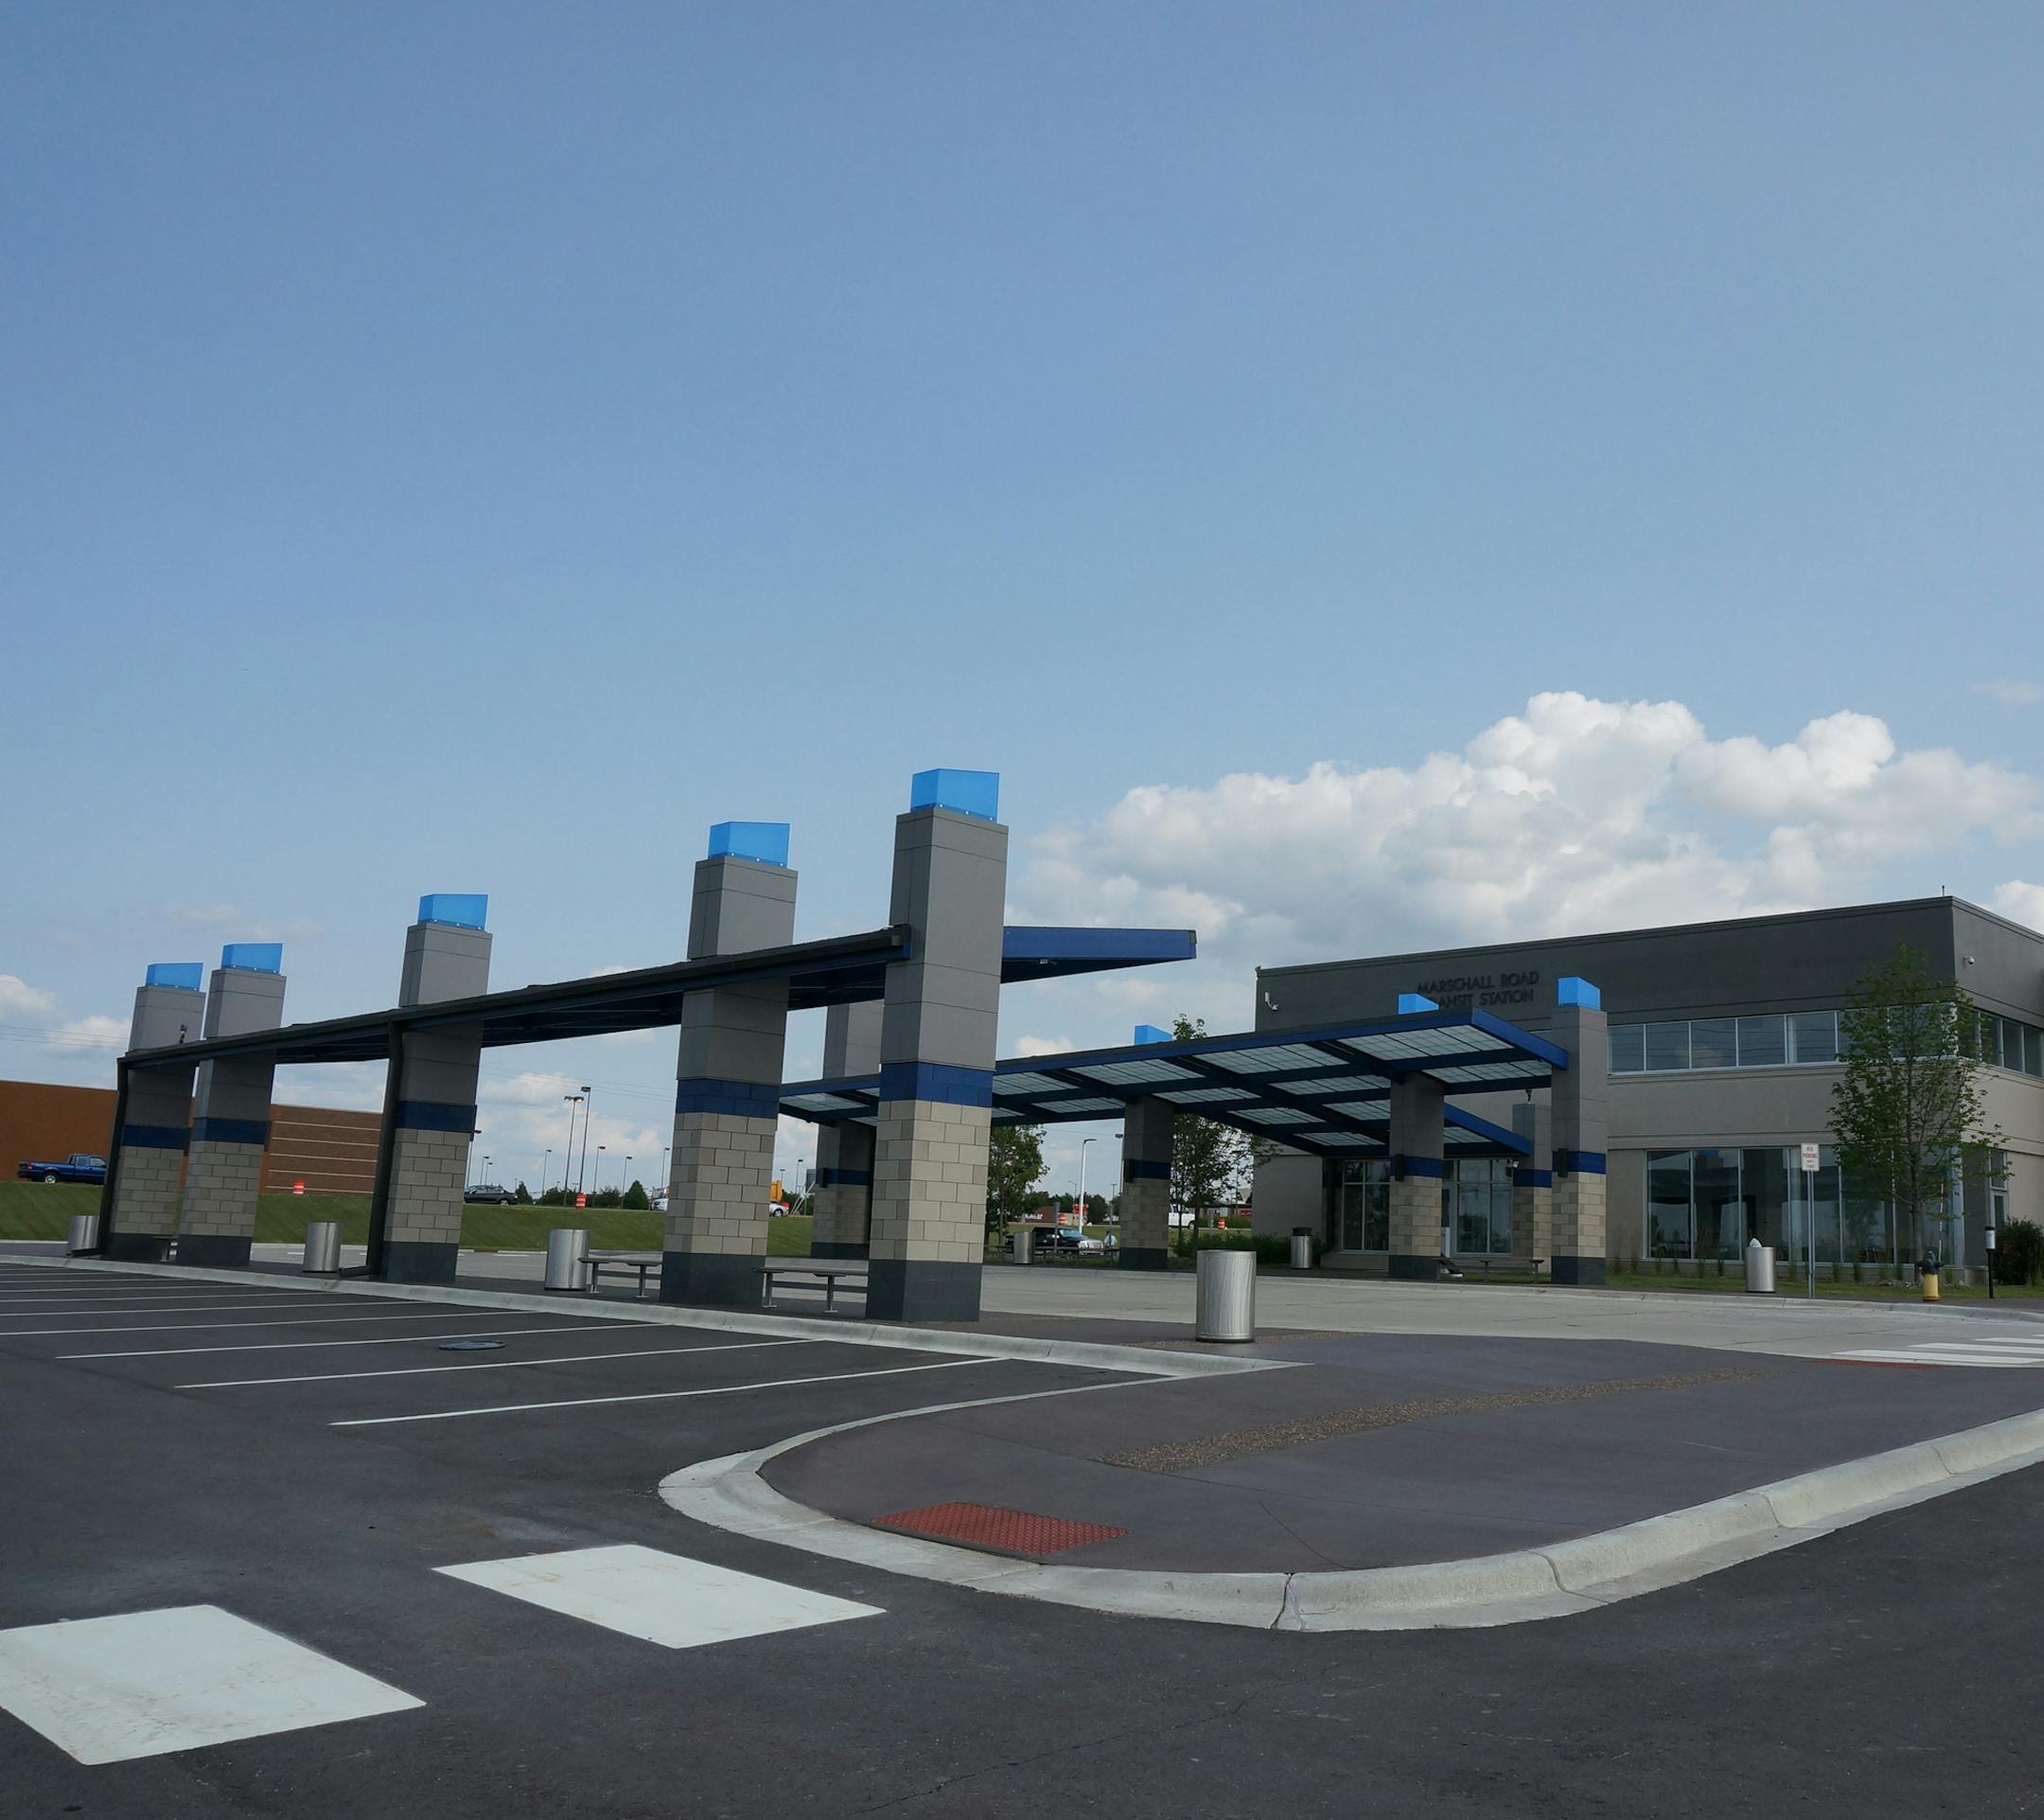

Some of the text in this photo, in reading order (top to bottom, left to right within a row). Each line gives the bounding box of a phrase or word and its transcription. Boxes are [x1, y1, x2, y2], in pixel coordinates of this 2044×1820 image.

[1418, 971, 1540, 994] MARSCHALL ROAD
[1479, 988, 1534, 1006] STATION
